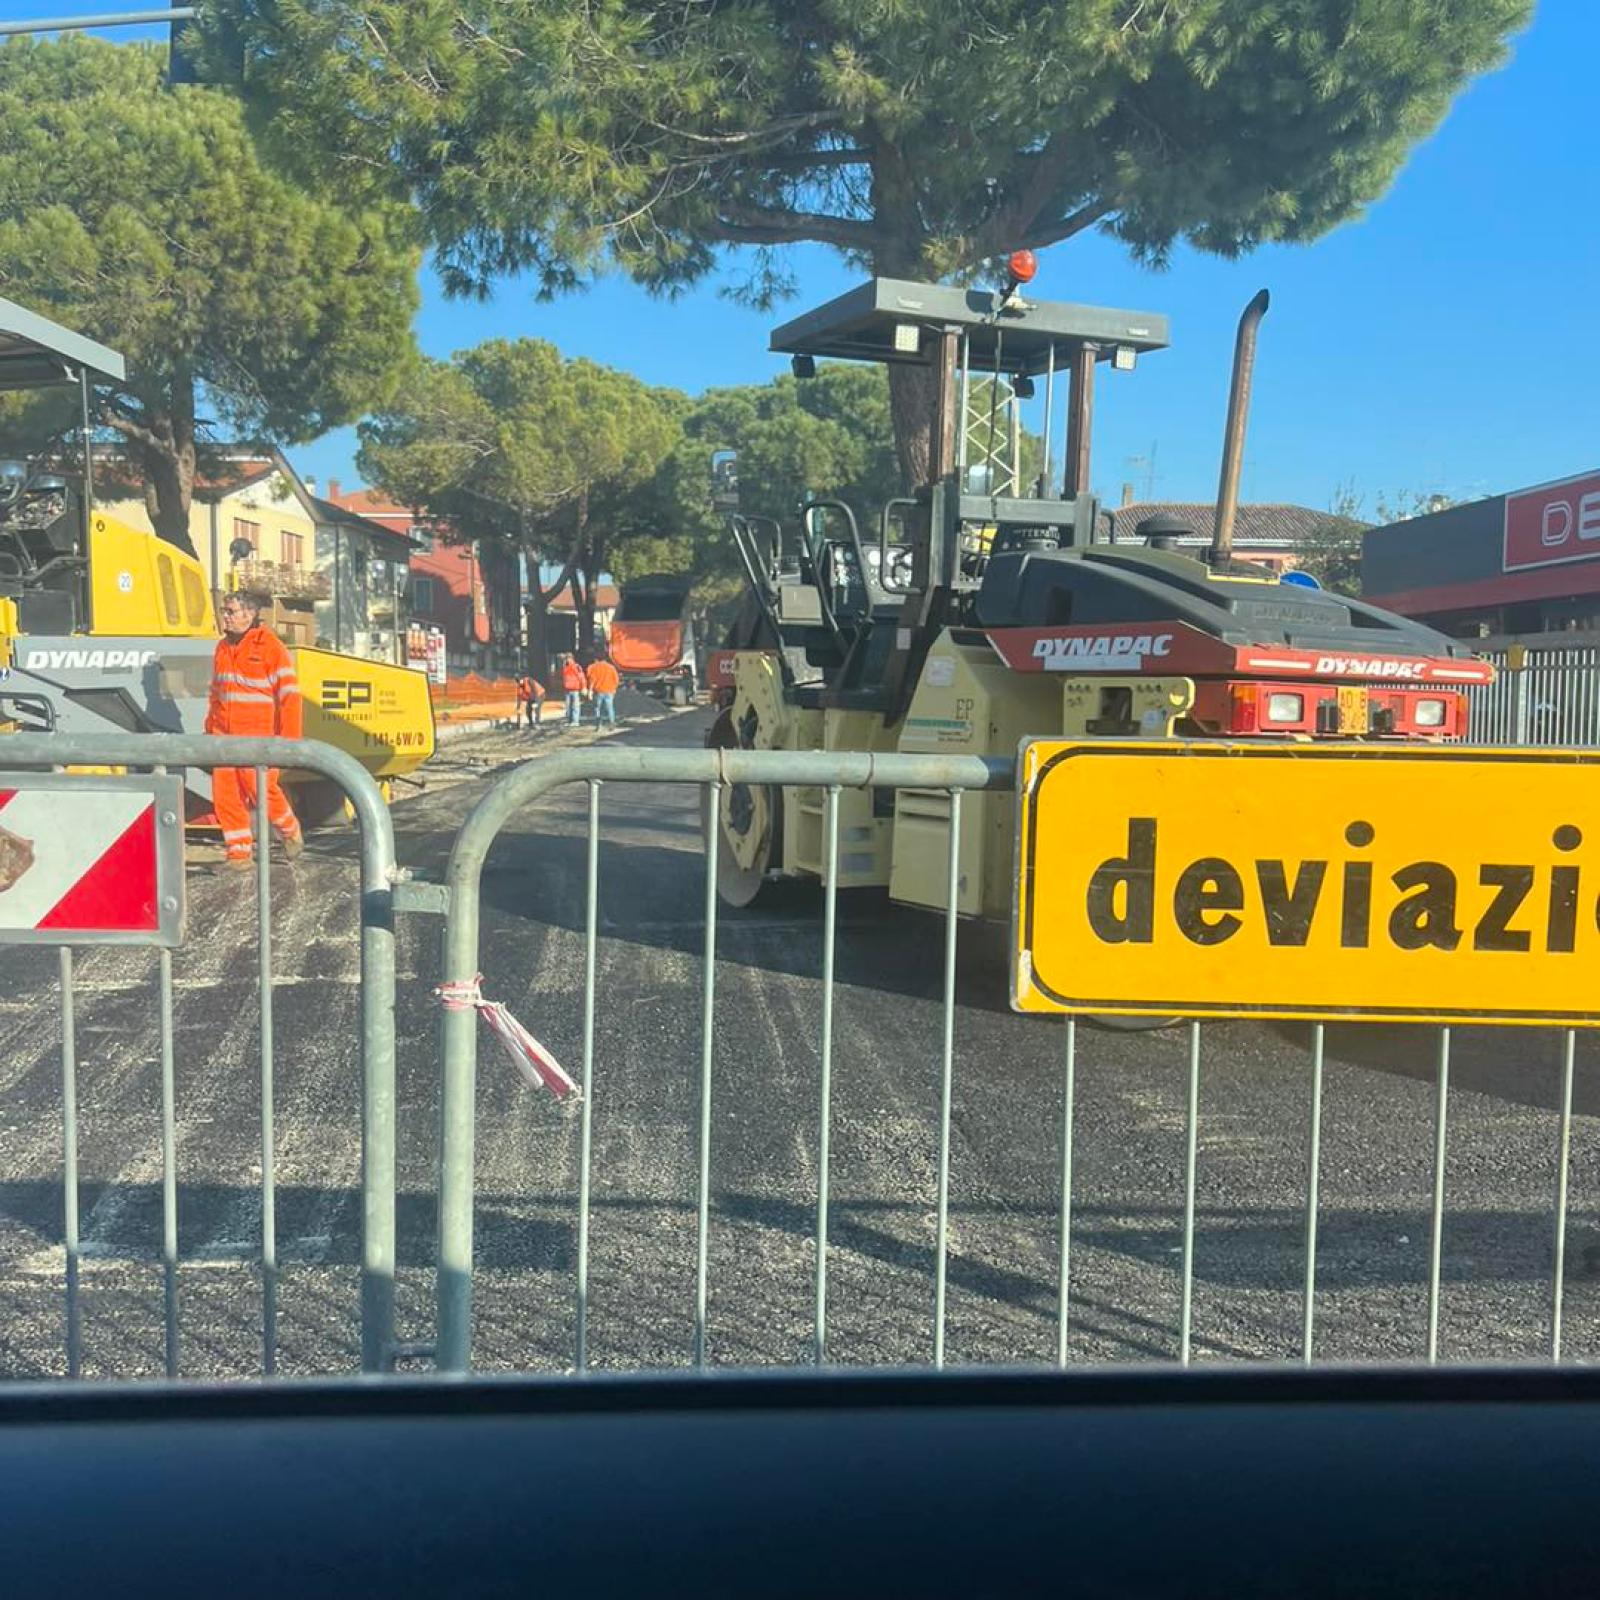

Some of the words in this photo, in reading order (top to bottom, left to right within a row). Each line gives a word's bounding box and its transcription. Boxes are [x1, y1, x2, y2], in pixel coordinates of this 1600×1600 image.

[1032, 634, 1173, 657] DYNAPAC
[1315, 657, 1427, 679] DYNAPAC
[322, 680, 371, 709] EP
[956, 698, 974, 720] EP
[1086, 817, 1600, 953] deviazi
